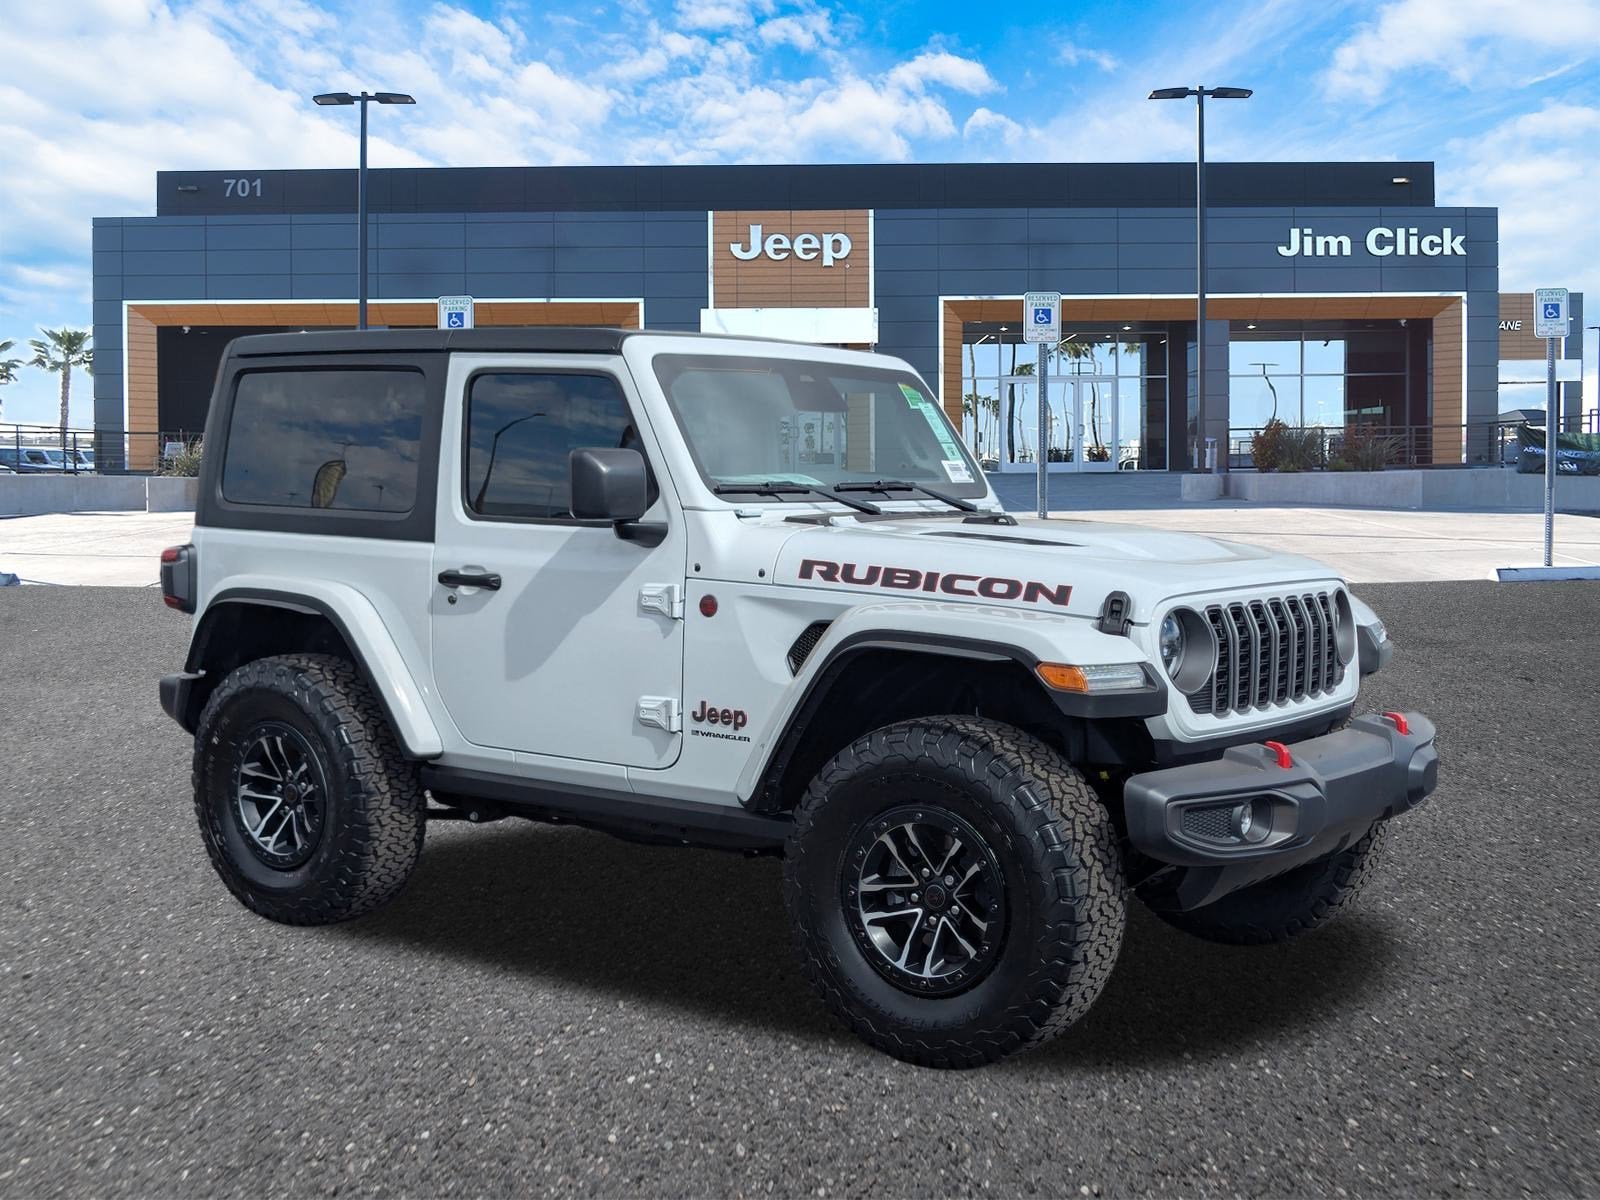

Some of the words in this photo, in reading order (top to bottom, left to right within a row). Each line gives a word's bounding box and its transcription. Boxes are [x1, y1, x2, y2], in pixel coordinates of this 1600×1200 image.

[223, 178, 261, 197] 701
[729, 224, 852, 267] Jeep
[1277, 228, 1352, 257] Jim
[1365, 227, 1467, 256] Click
[1498, 320, 1522, 331] ANE
[798, 558, 1073, 606] RUBICON
[692, 700, 748, 732] Jeep
[700, 730, 751, 743] WRANGLER
